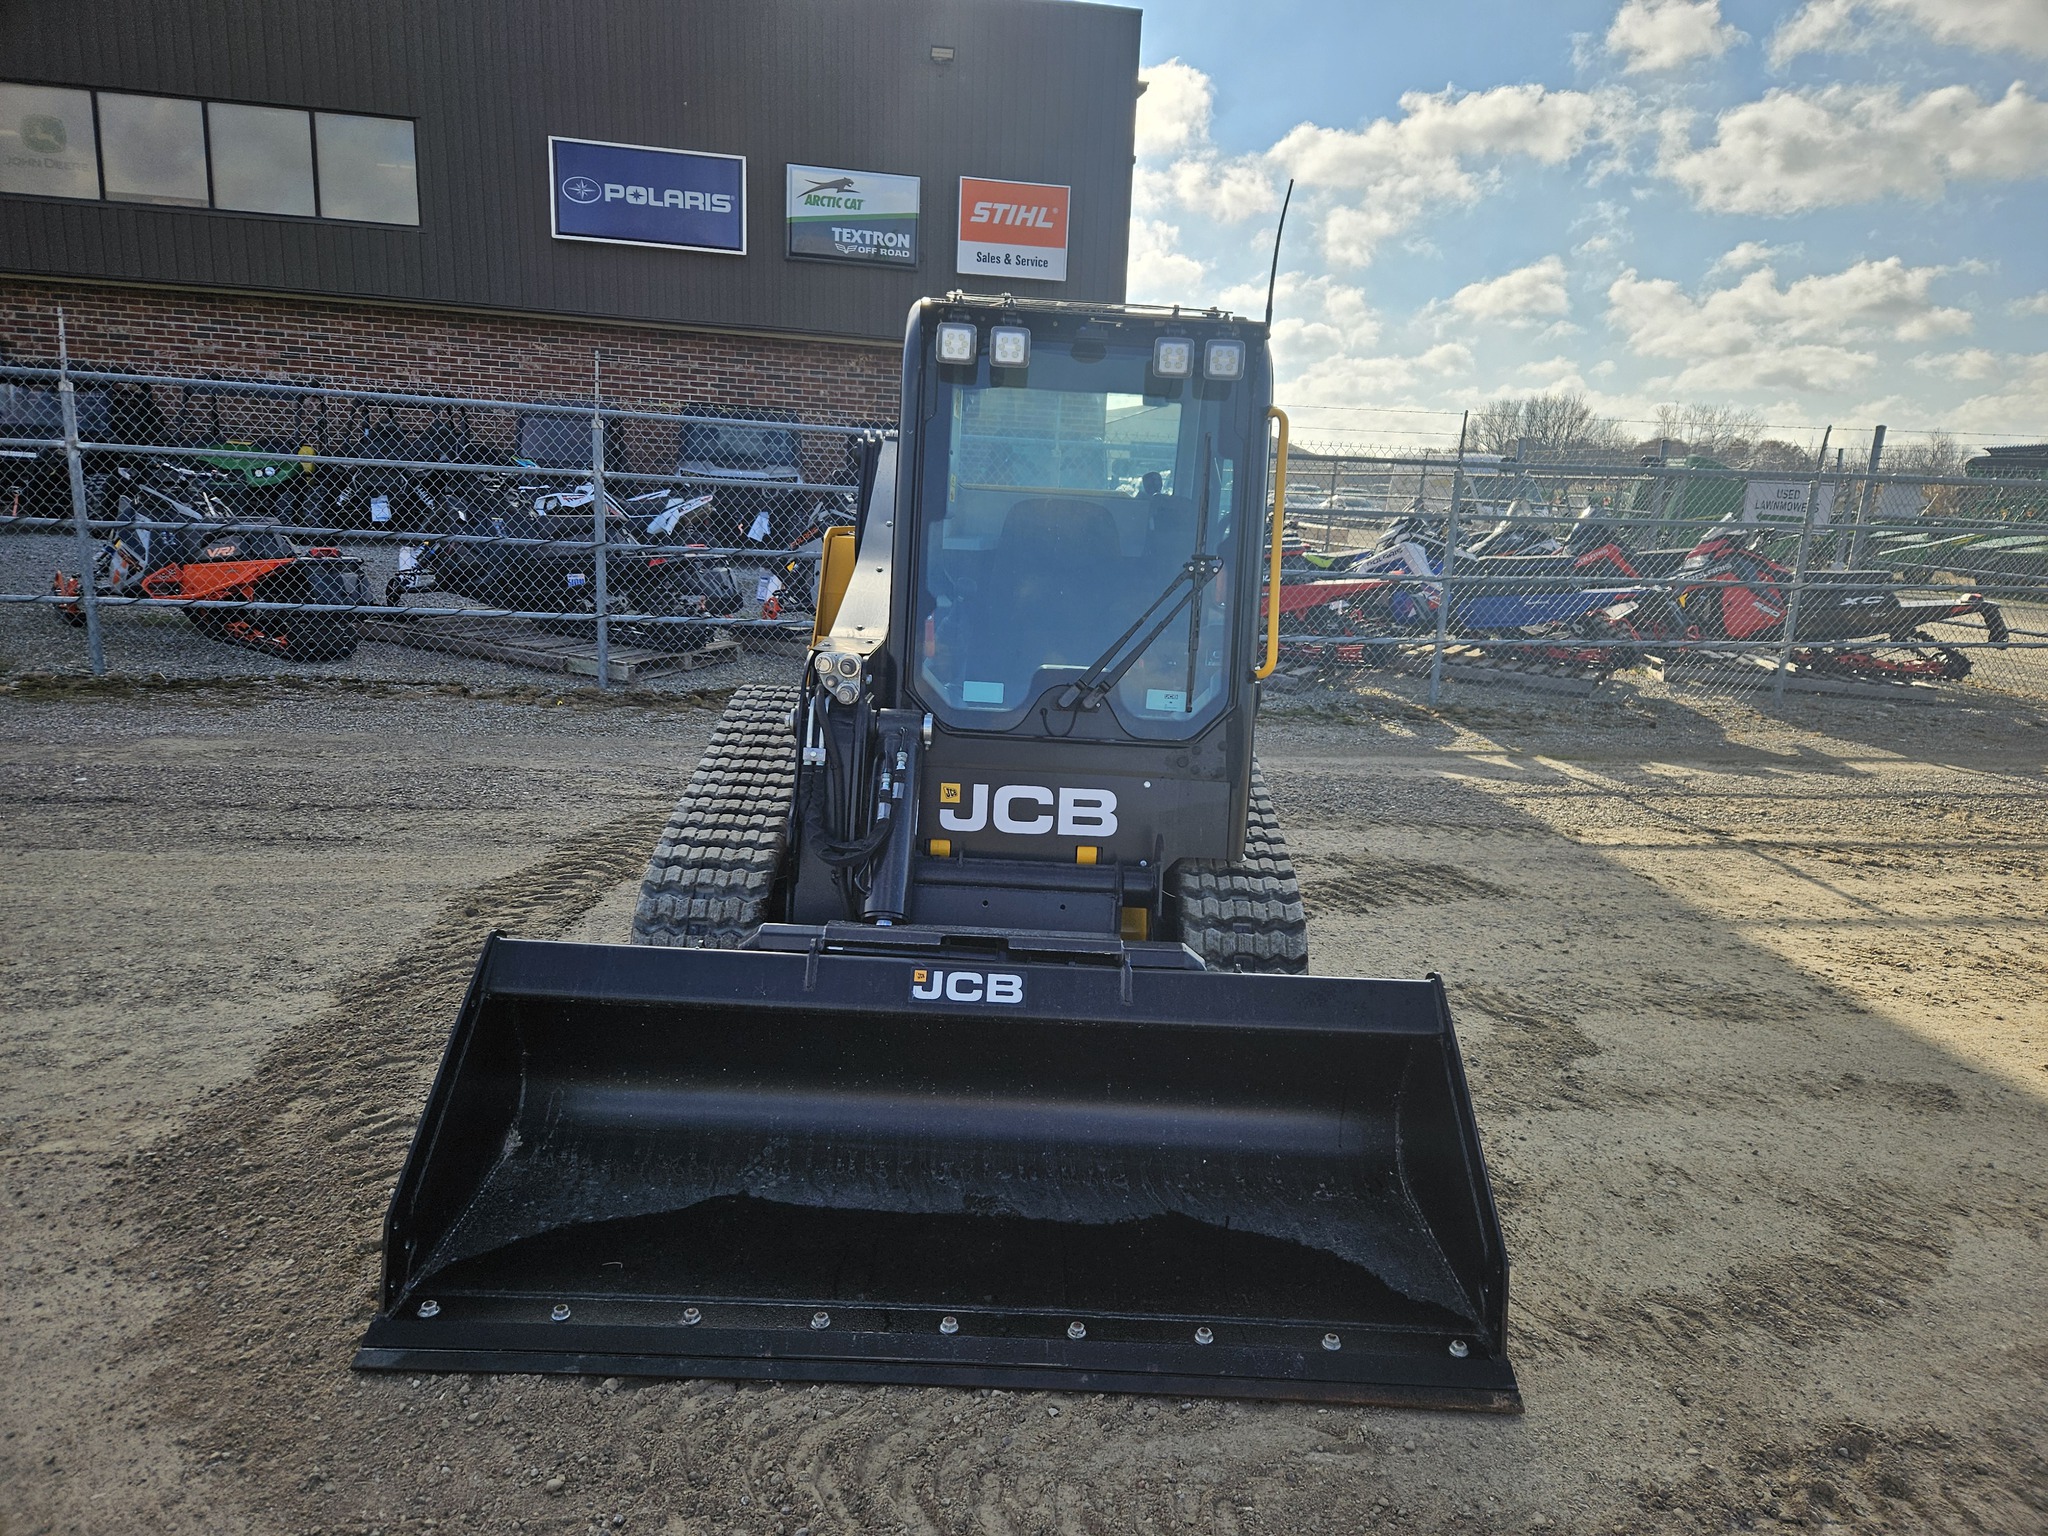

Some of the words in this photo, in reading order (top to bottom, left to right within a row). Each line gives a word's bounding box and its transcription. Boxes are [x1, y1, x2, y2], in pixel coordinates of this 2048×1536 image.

[604, 183, 732, 213] POLARIS
[804, 193, 842, 208] ARCTIC
[843, 197, 864, 210] CAT
[970, 201, 1054, 228] STIHL
[831, 227, 910, 248] TEXTRON
[857, 246, 877, 254] OFF
[880, 248, 910, 258] ROAD
[976, 251, 1001, 264] Sales
[1003, 253, 1012, 265] &
[1015, 255, 1049, 268] Service
[1776, 488, 1801, 500] USED
[1755, 499, 1820, 513] LAWNMOWES
[939, 783, 1118, 837] JCB
[912, 970, 1023, 1004] JCB
